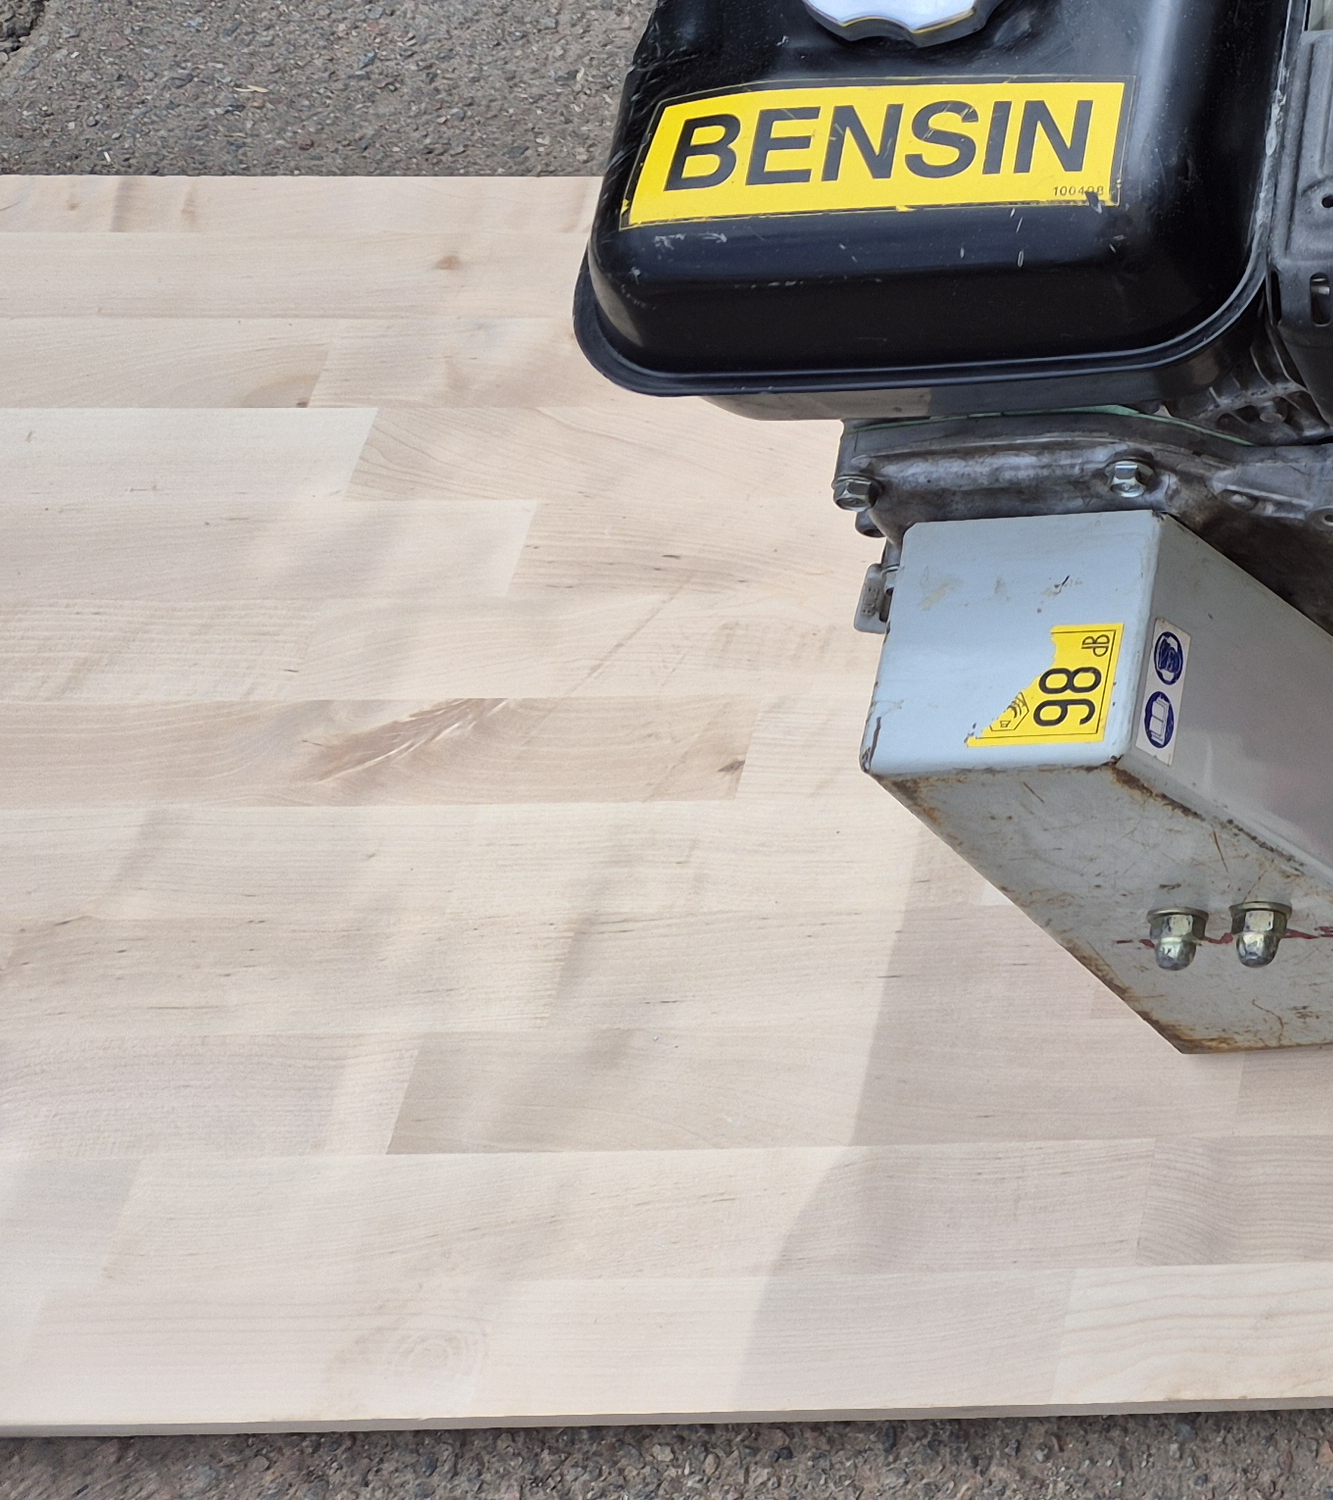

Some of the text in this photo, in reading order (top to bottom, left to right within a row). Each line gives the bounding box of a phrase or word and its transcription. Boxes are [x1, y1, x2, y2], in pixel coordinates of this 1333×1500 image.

[664, 100, 1094, 191] BENSIN
[1033, 634, 1110, 727] 98 dB
